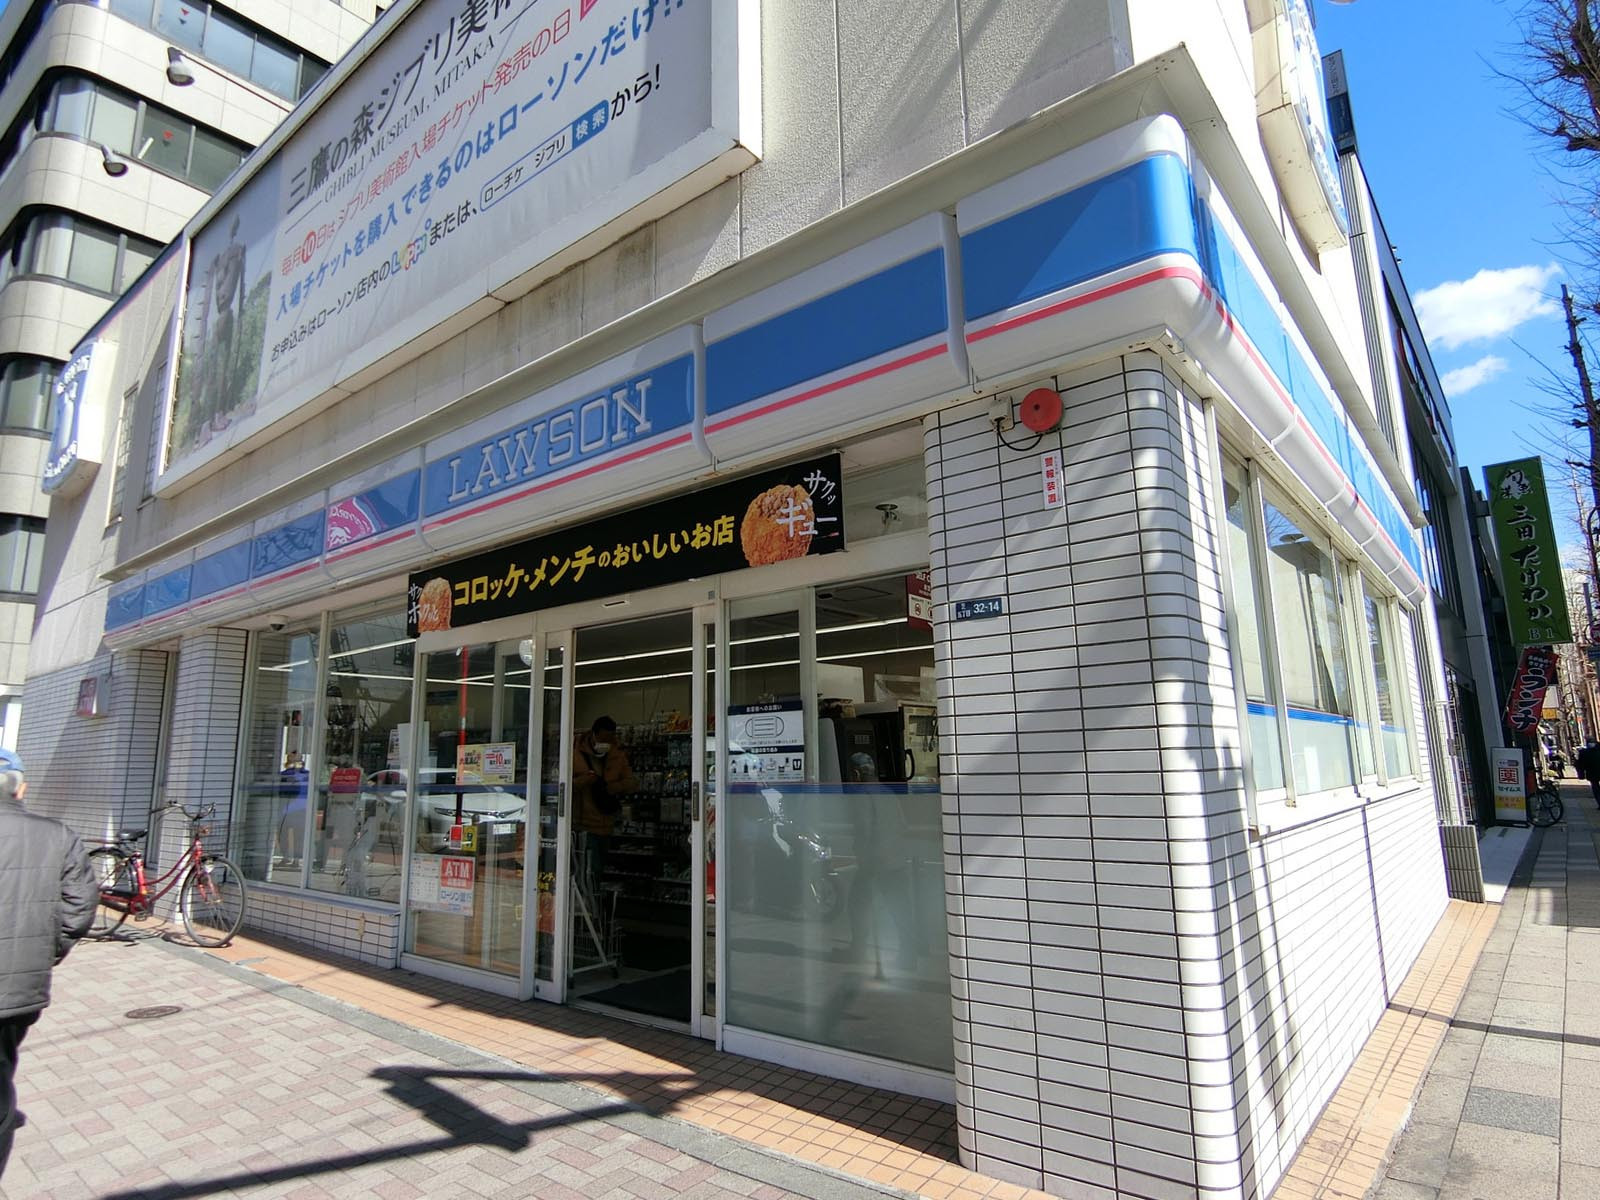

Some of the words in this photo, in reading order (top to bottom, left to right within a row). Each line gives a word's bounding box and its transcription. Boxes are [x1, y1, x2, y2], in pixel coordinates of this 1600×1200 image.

[325, 157, 366, 204] GHIBLI
[369, 103, 430, 164] MUSEUM,
[433, 35, 495, 102] MITAKA
[534, 135, 566, 168] ジブリ
[448, 378, 652, 502] LAWSON
[454, 515, 735, 607] コロッケ・メンチのおいしいお店
[973, 601, 1000, 614] 32-14
[445, 861, 470, 879] ATM
